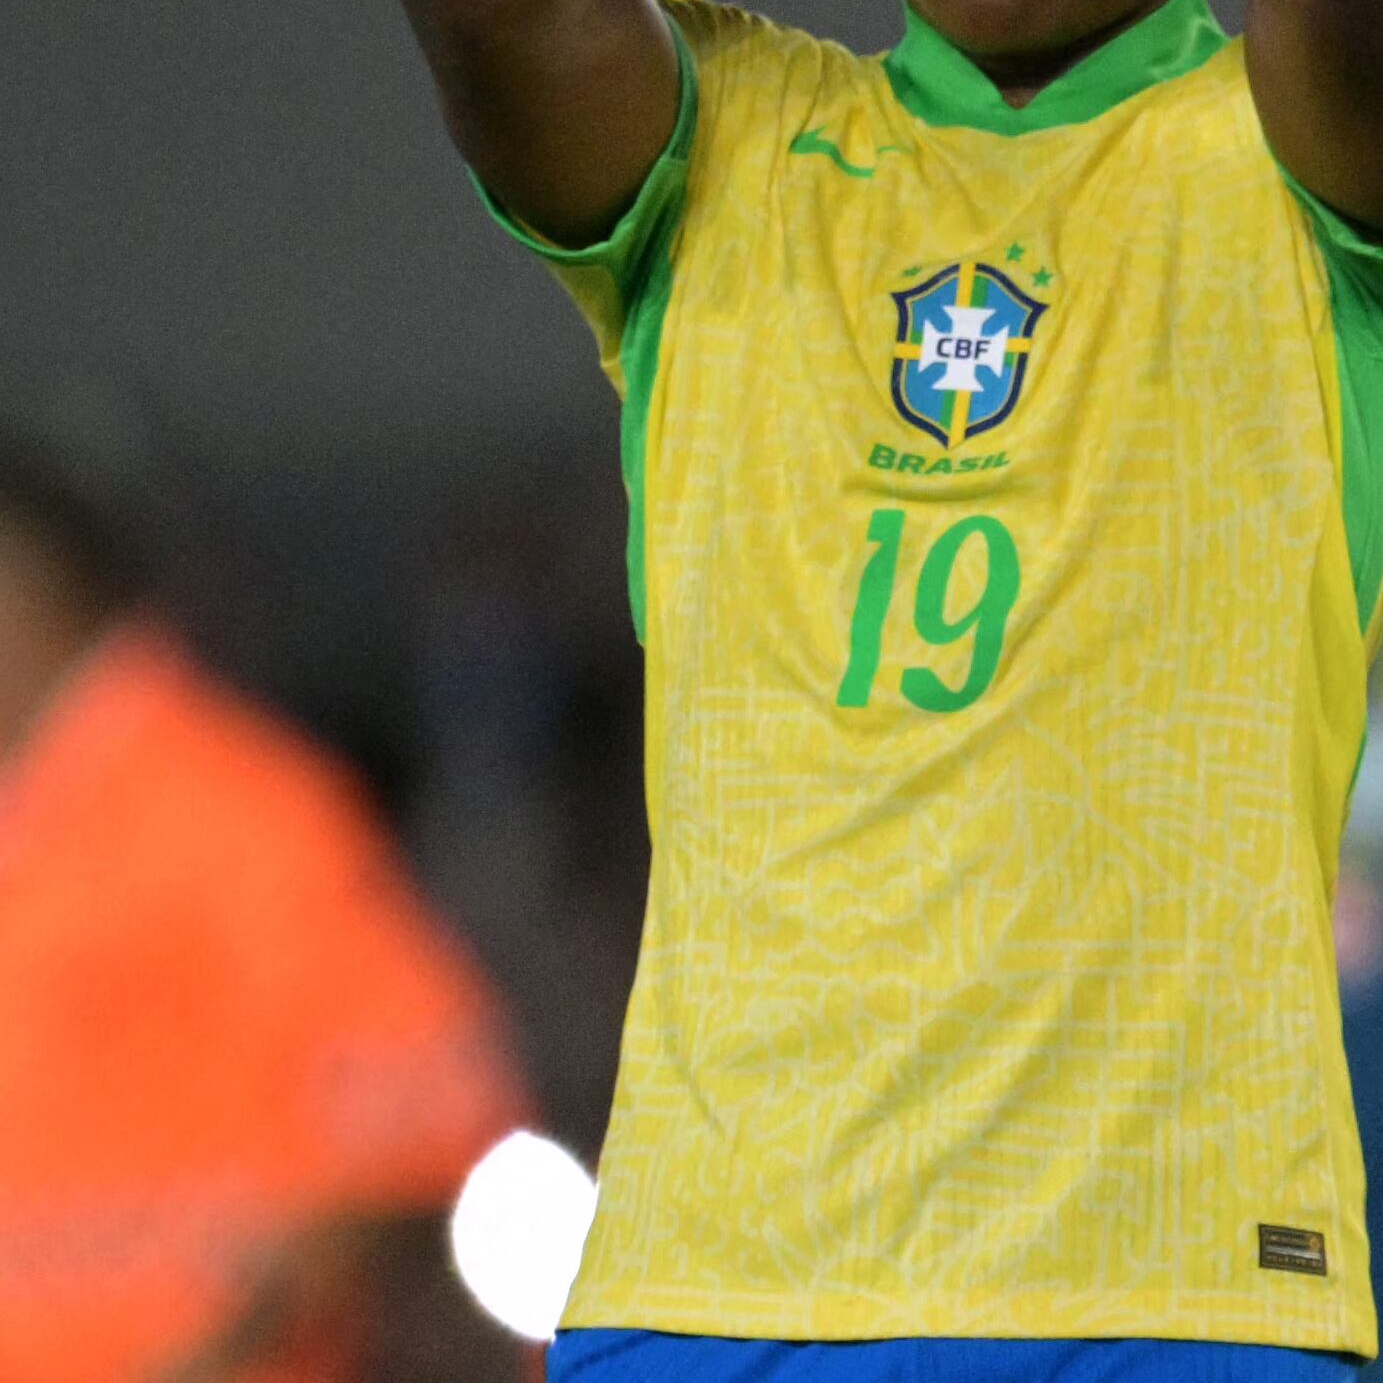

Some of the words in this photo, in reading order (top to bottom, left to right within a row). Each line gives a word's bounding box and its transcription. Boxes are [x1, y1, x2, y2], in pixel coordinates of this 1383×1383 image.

[937, 337, 990, 359] CBF
[869, 443, 1009, 475] BRASIL
[836, 509, 1021, 713] 19
